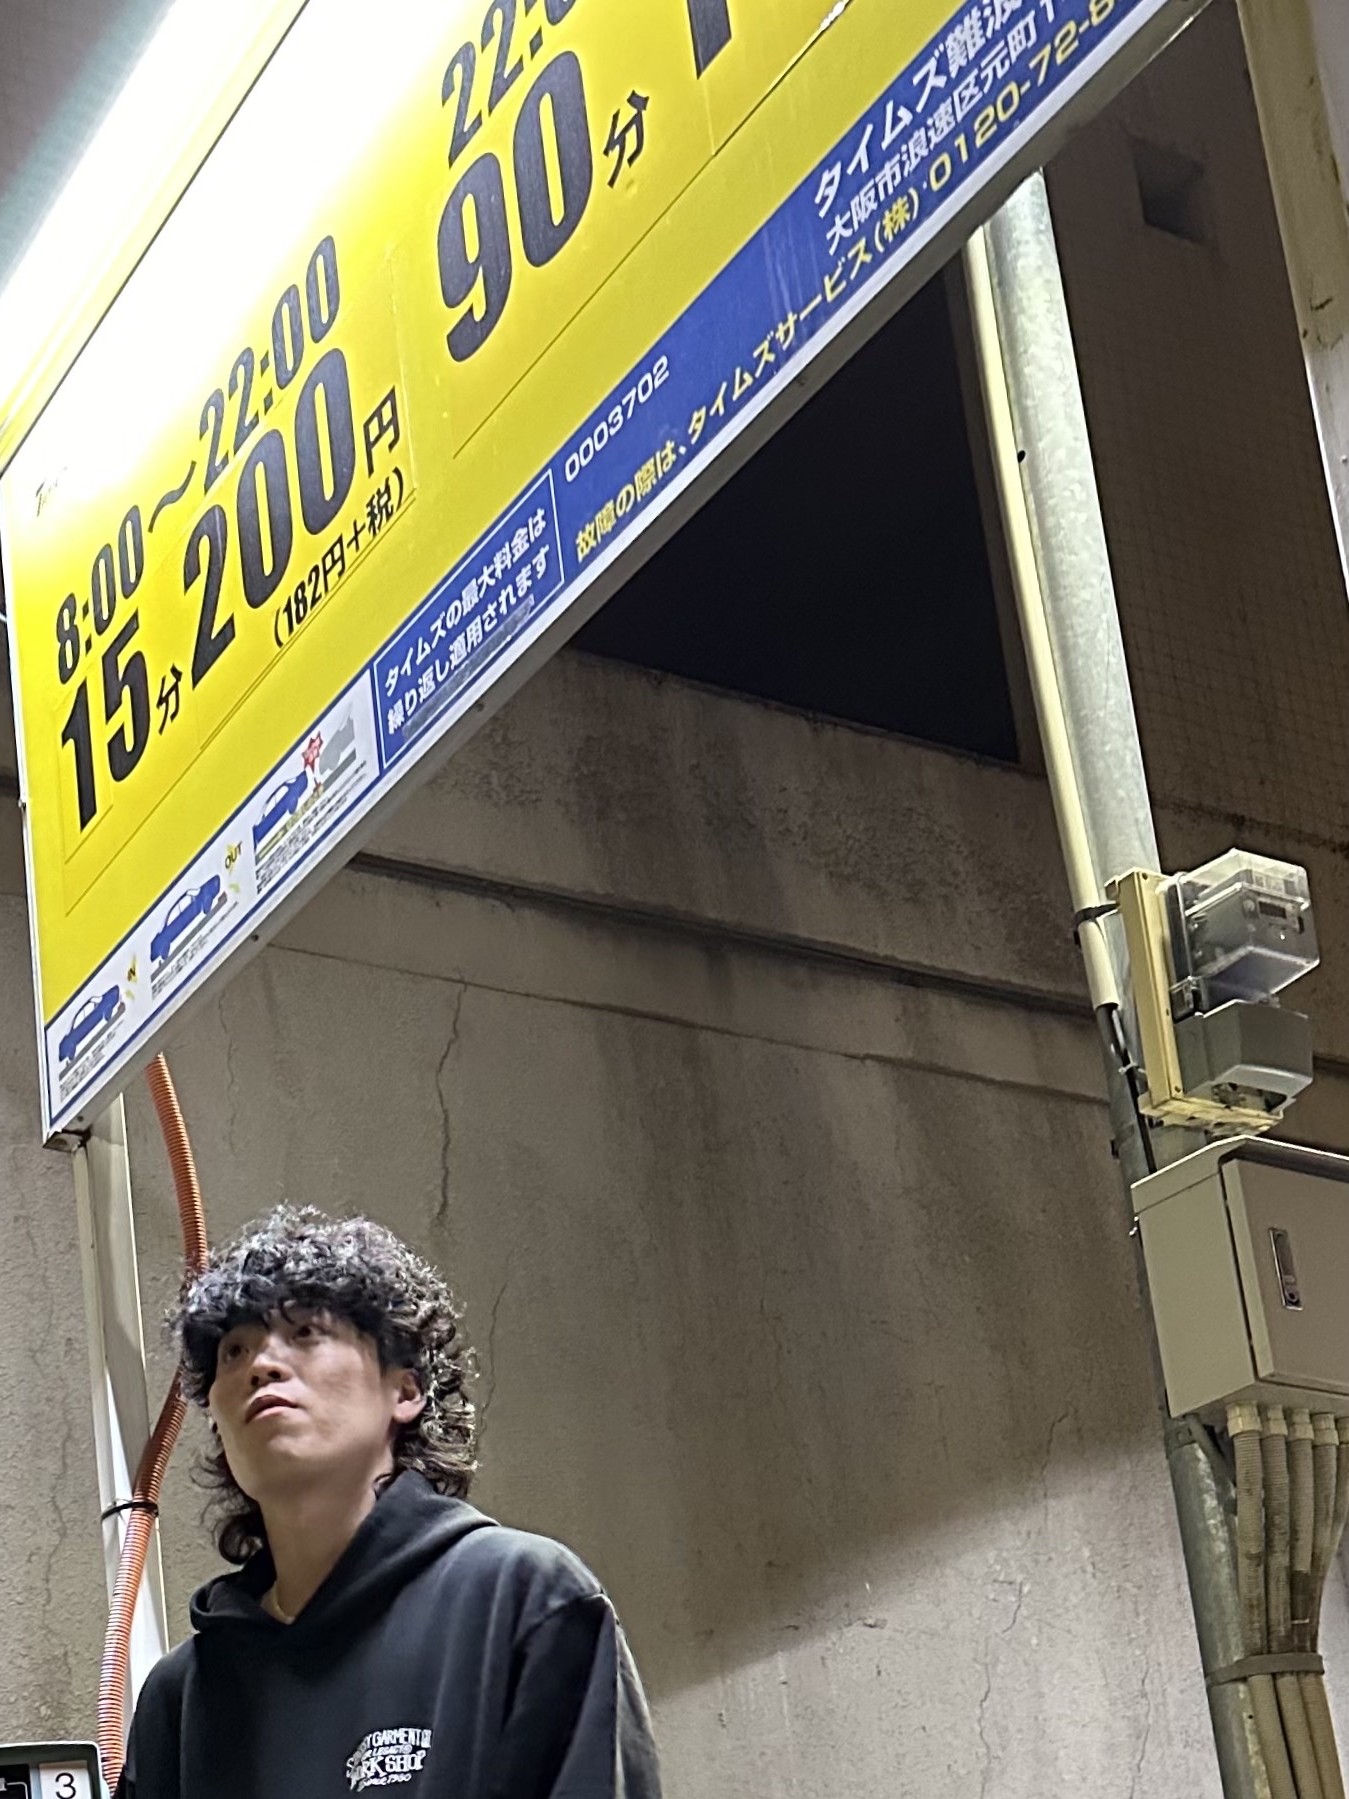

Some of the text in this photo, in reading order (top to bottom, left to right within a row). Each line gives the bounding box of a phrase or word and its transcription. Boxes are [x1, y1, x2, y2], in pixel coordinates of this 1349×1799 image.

[565, 355, 669, 483] 0003702
[274, 466, 404, 648] (182円+税)
[384, 507, 547, 697] タイムズの最大料金は
[387, 545, 550, 735] 繰り返し適用されます
[224, 841, 243, 869] OUT
[372, 1728, 422, 1748] GARMENT
[385, 1750, 427, 1772] SHOP
